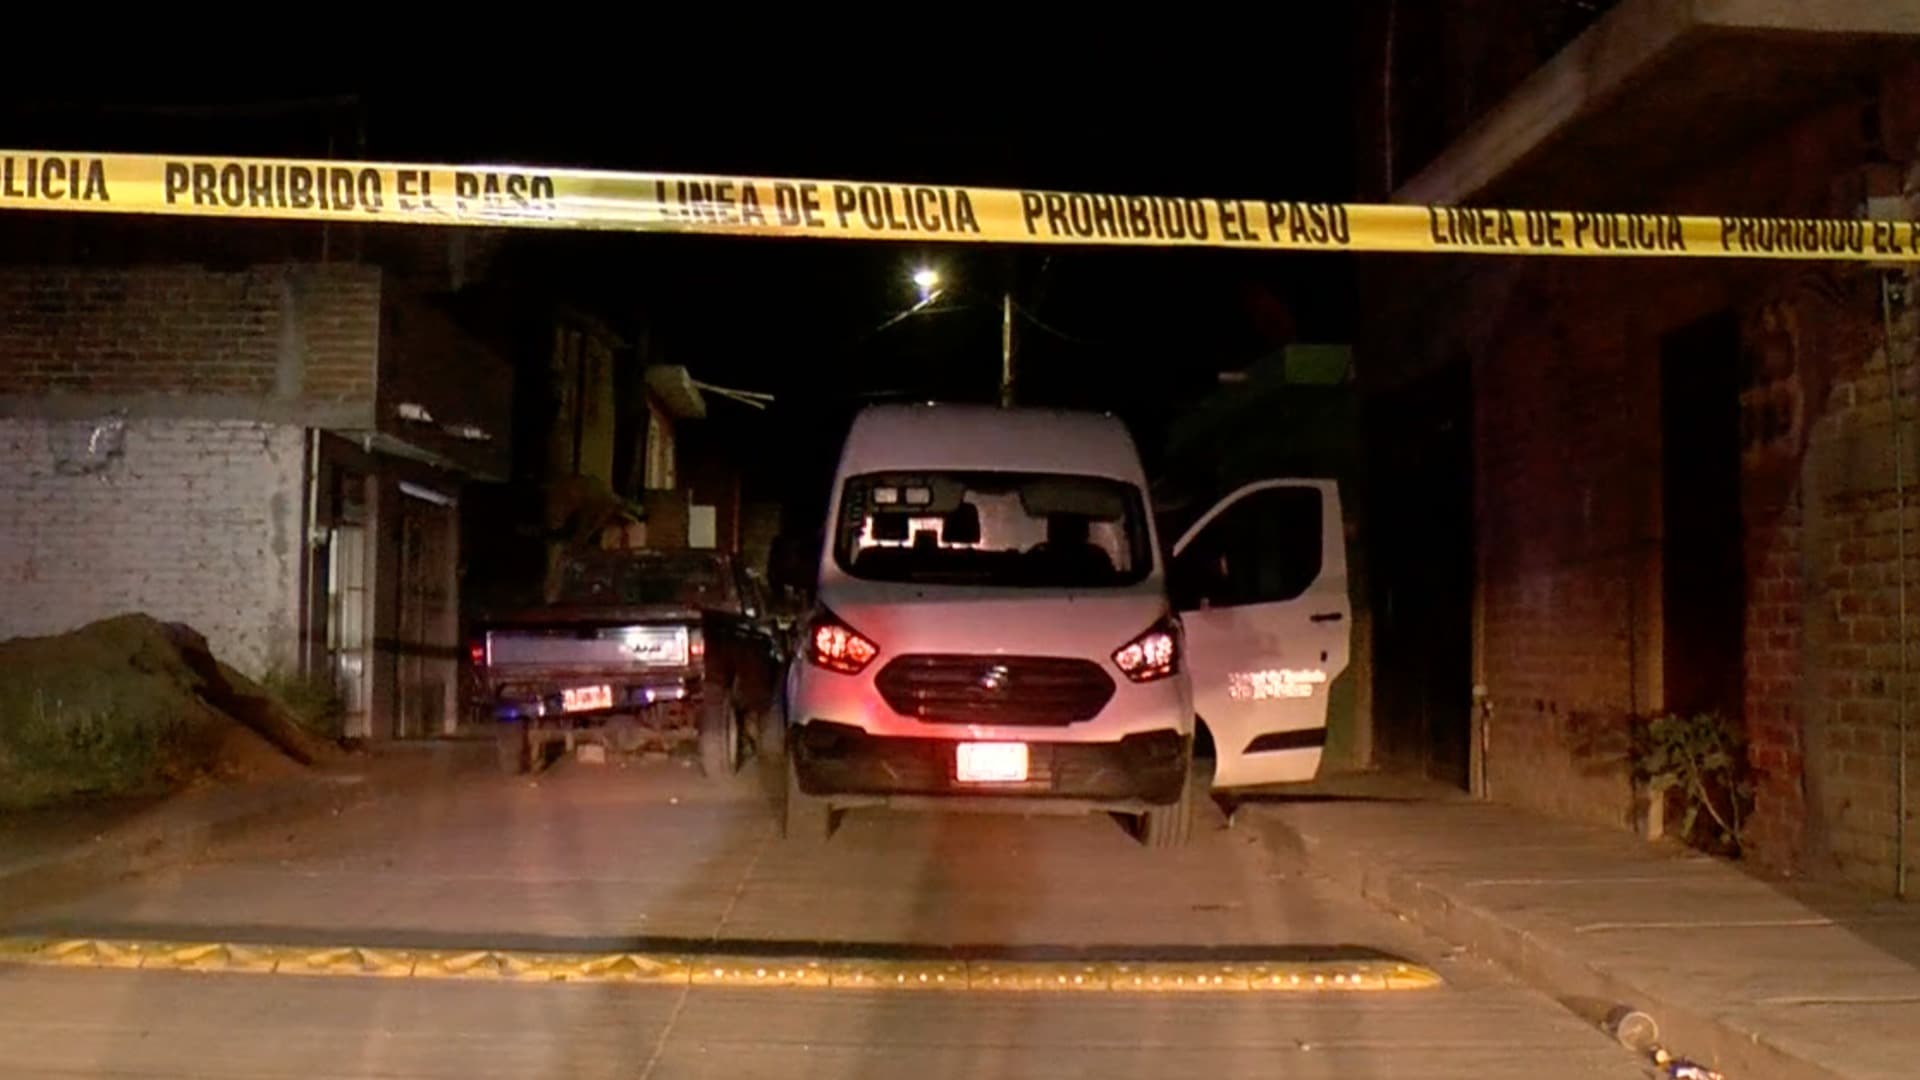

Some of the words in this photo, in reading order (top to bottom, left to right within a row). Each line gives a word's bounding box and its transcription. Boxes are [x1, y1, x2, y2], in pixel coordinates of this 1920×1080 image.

[165, 161, 384, 213] PROHIBIDO
[397, 169, 433, 209] EL
[774, 182, 825, 227] DE
[833, 185, 980, 233] POLICIA
[1020, 191, 1208, 241] PROHIBIDO
[1216, 200, 1260, 241] EL
[1264, 201, 1350, 245] PASO
[1428, 204, 1518, 246] LINEA
[1523, 209, 1564, 248] DE
[1570, 212, 1687, 251] POLICIA
